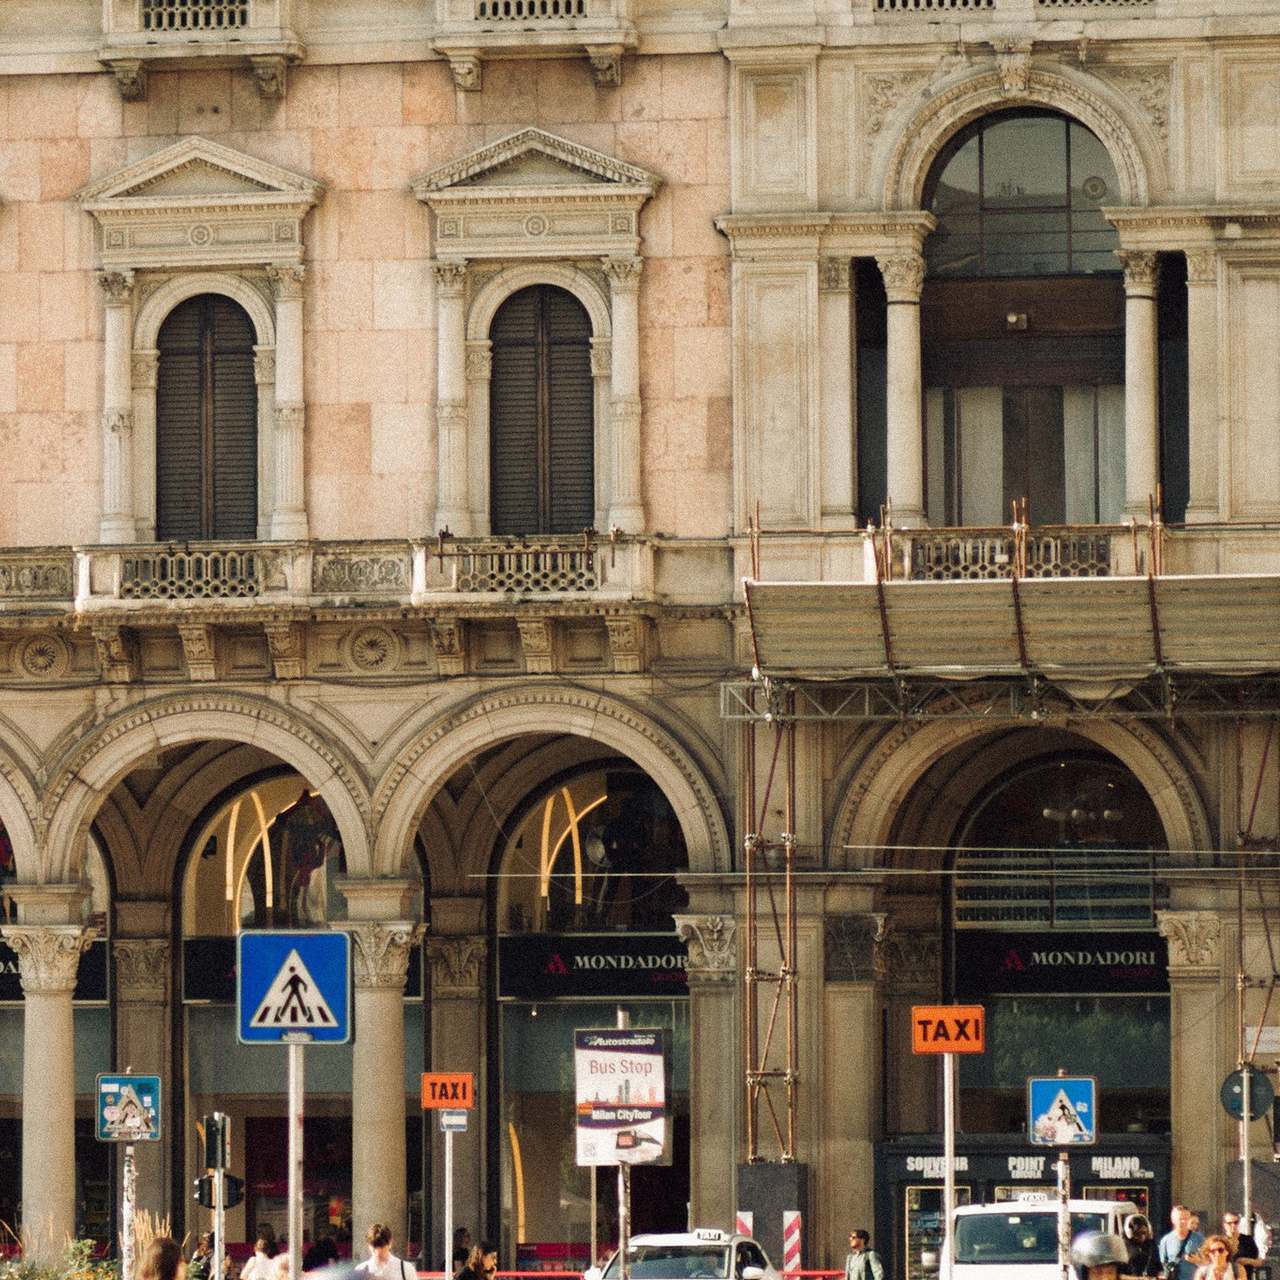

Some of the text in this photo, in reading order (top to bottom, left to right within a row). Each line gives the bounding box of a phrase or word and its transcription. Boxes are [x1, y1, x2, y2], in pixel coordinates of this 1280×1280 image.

[573, 955, 688, 970] MONDADOR
[1030, 951, 1156, 966] MONDADORI
[917, 1018, 980, 1042] TAXI
[589, 1036, 656, 1047] Autostradale
[589, 1059, 652, 1076] Bus Stop
[430, 1081, 467, 1100] TAXI
[591, 1110, 616, 1121] Milan
[906, 1156, 969, 1171] SOUVEIR
[1007, 1156, 1046, 1171] POINT
[1091, 1156, 1140, 1171] MILANO
